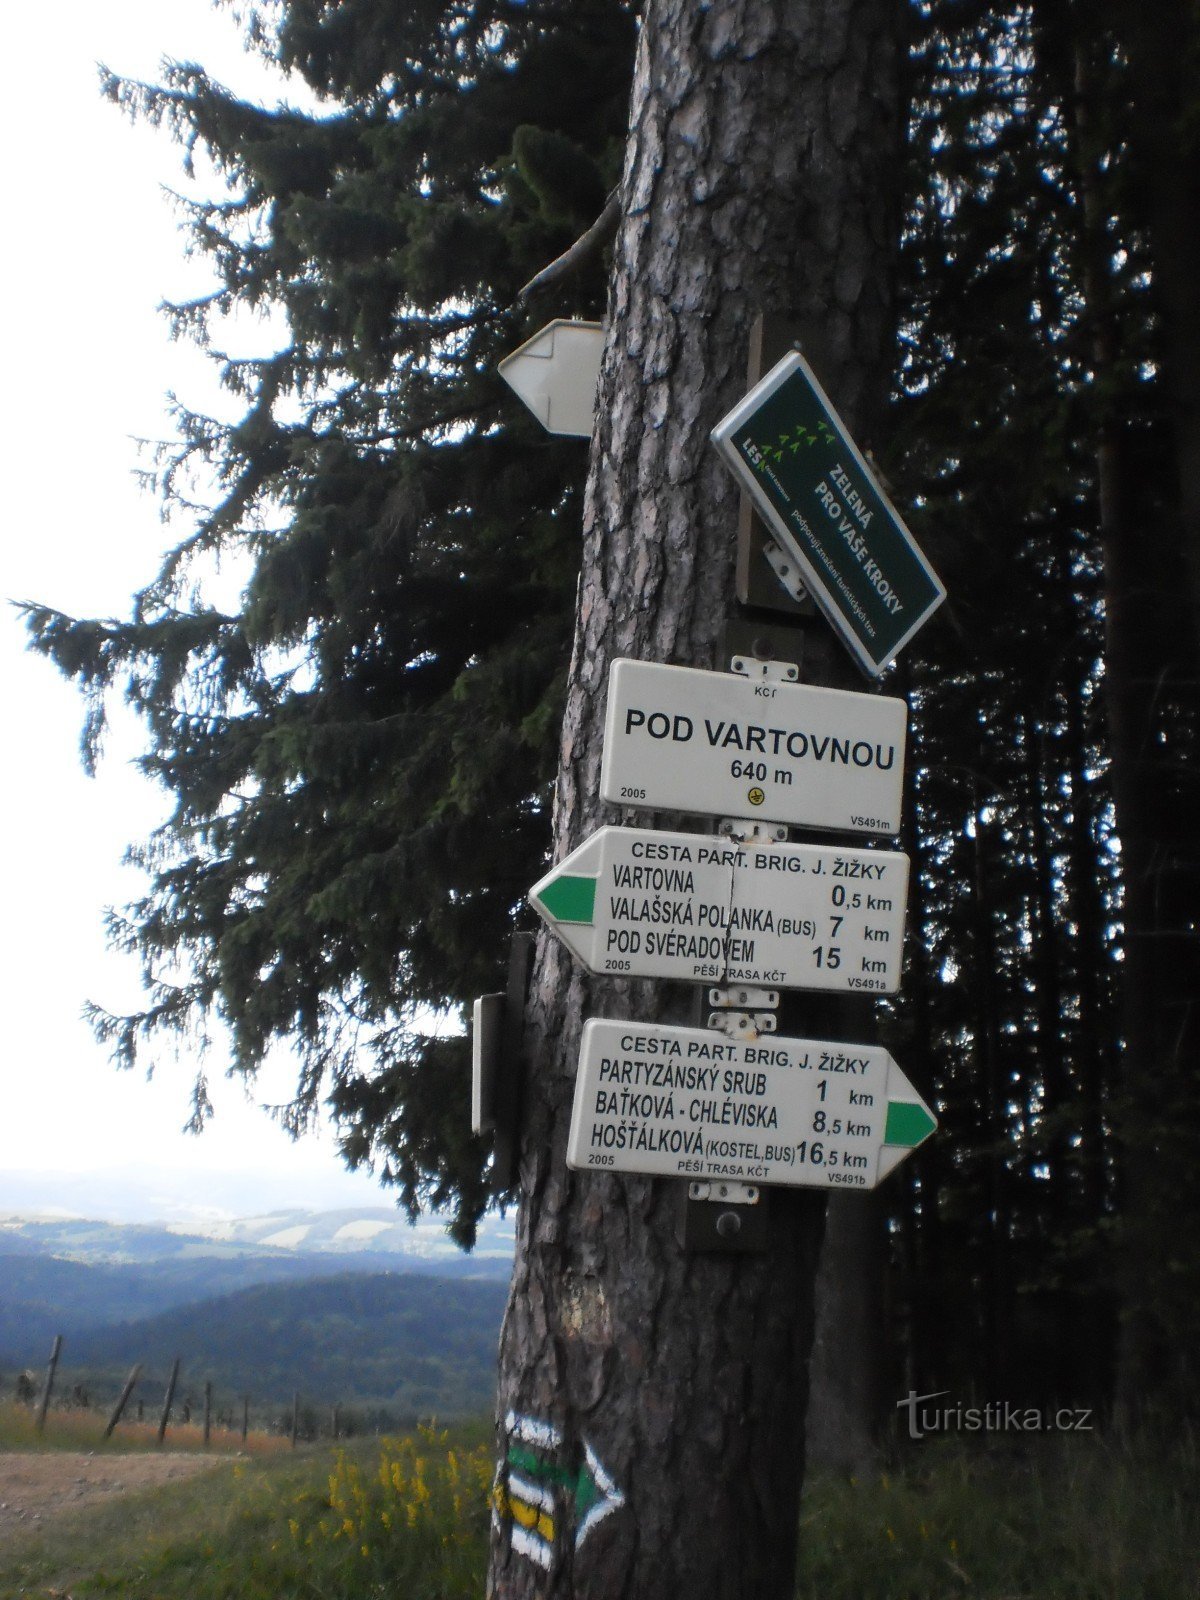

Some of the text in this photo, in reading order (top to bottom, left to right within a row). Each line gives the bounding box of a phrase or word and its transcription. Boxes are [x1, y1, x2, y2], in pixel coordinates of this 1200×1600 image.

[829, 463, 874, 529] ZELENÁ
[814, 481, 904, 615] PRO VAŠE KROKY
[790, 508, 821, 548] podporují
[863, 620, 876, 636] tras
[625, 709, 894, 770] POD VARTOVNOU
[731, 760, 792, 785] 640 m
[621, 787, 890, 830] 2005 VS491m
[632, 842, 887, 880] CESTA PART. BRIG. J. ŽIŽKY
[613, 864, 892, 911] VARTOVNA 0,5 km
[610, 895, 889, 942] VALAŠSKÁ POLANKA (BUS) 7 km
[607, 928, 887, 973] POD SVÉRADOVEM 15 km
[605, 960, 886, 989] 2005 PĚŠÍ TRASA KČT VS491a
[621, 1036, 870, 1074] CESTA PART. BRIG. J. ŽIŽKY
[600, 1059, 873, 1106] PARTYZÁNSKÝ SRUB 1 km
[595, 1087, 674, 1120] BAŤKOVÁ
[689, 1096, 778, 1129] CHLÉVISKA
[812, 1111, 842, 1136] 8,5
[846, 1121, 871, 1137] km
[591, 1120, 703, 1155] HOŠŤÁLKOVÁ
[797, 1141, 838, 1168] 16,5
[843, 1152, 867, 1168] km
[588, 1154, 865, 1185] 2005 PĚŠÍ TRASA KČT VS491b
